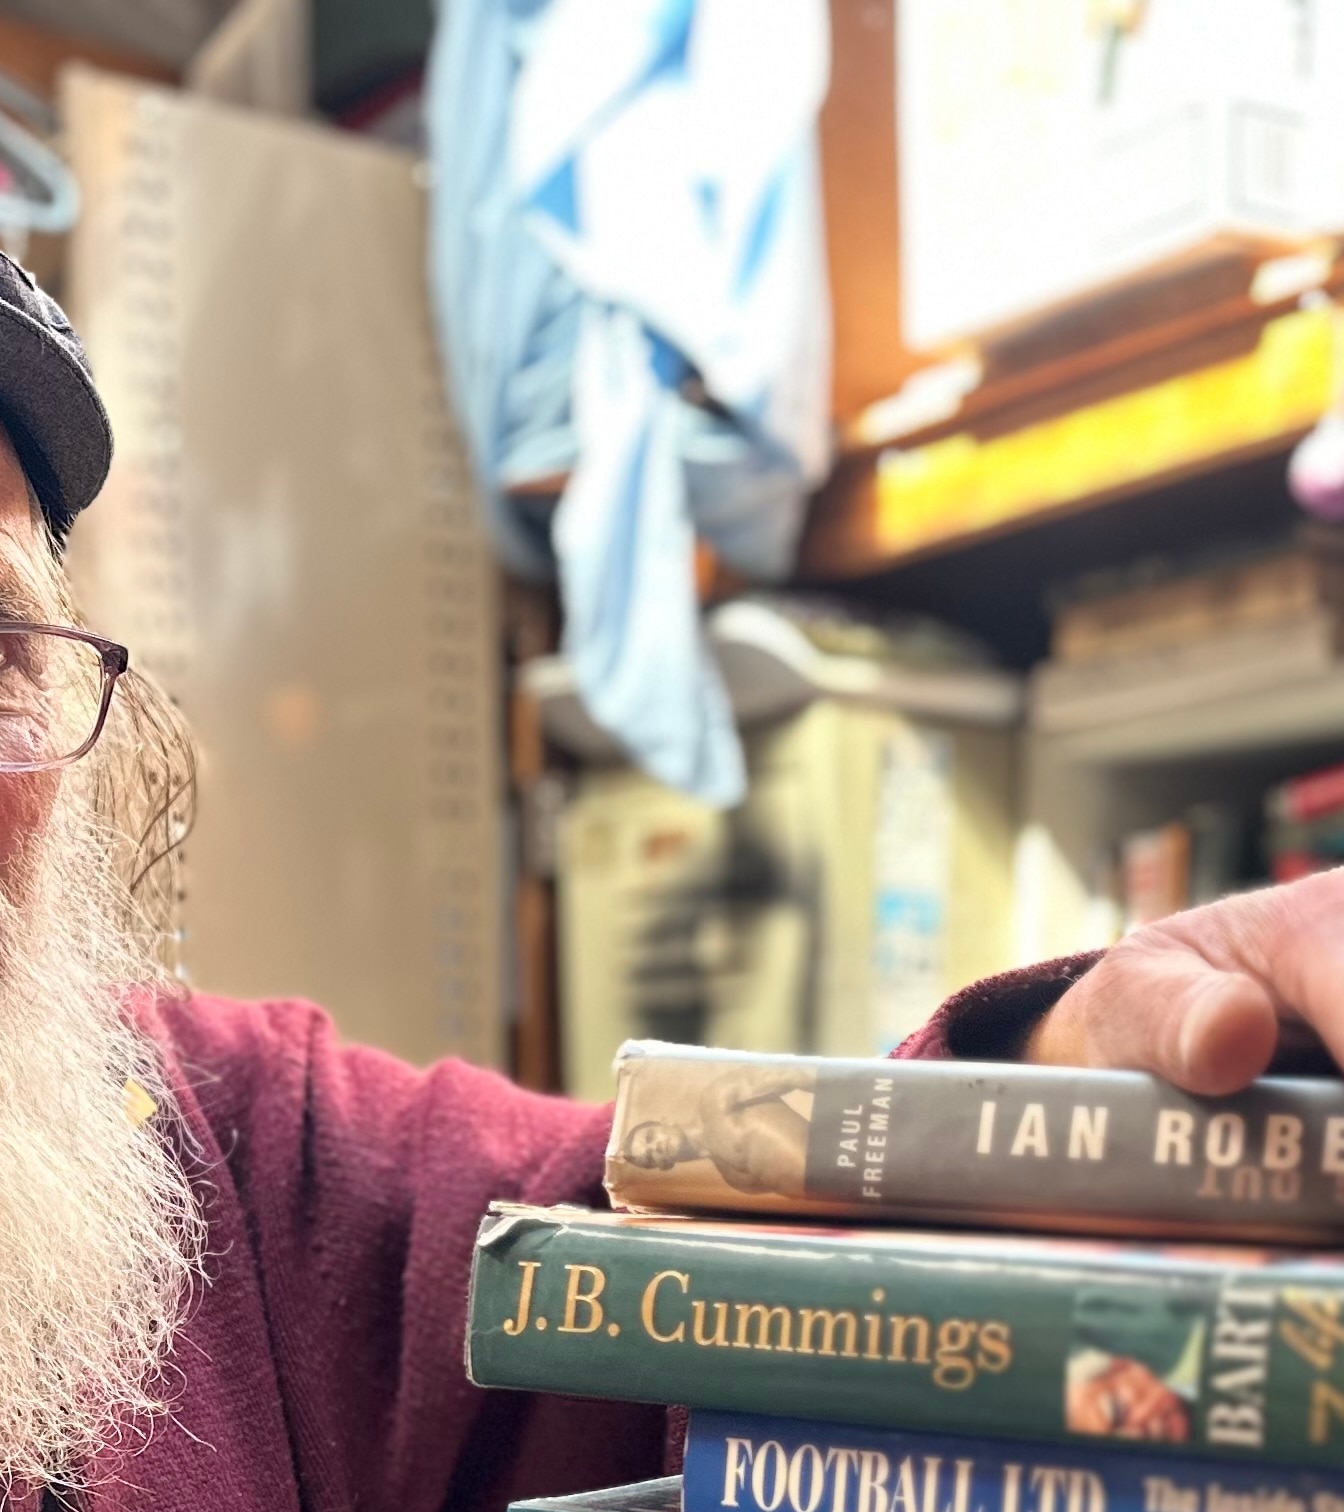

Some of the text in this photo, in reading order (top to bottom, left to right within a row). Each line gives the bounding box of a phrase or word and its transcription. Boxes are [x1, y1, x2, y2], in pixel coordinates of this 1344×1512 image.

[836, 1102, 863, 1168] PAUL
[862, 1076, 895, 1199] FREEMAN
[976, 1100, 1110, 1161] IAN
[502, 1260, 1013, 1391] J.B. Cummings
[1207, 1274, 1274, 1447] BART
